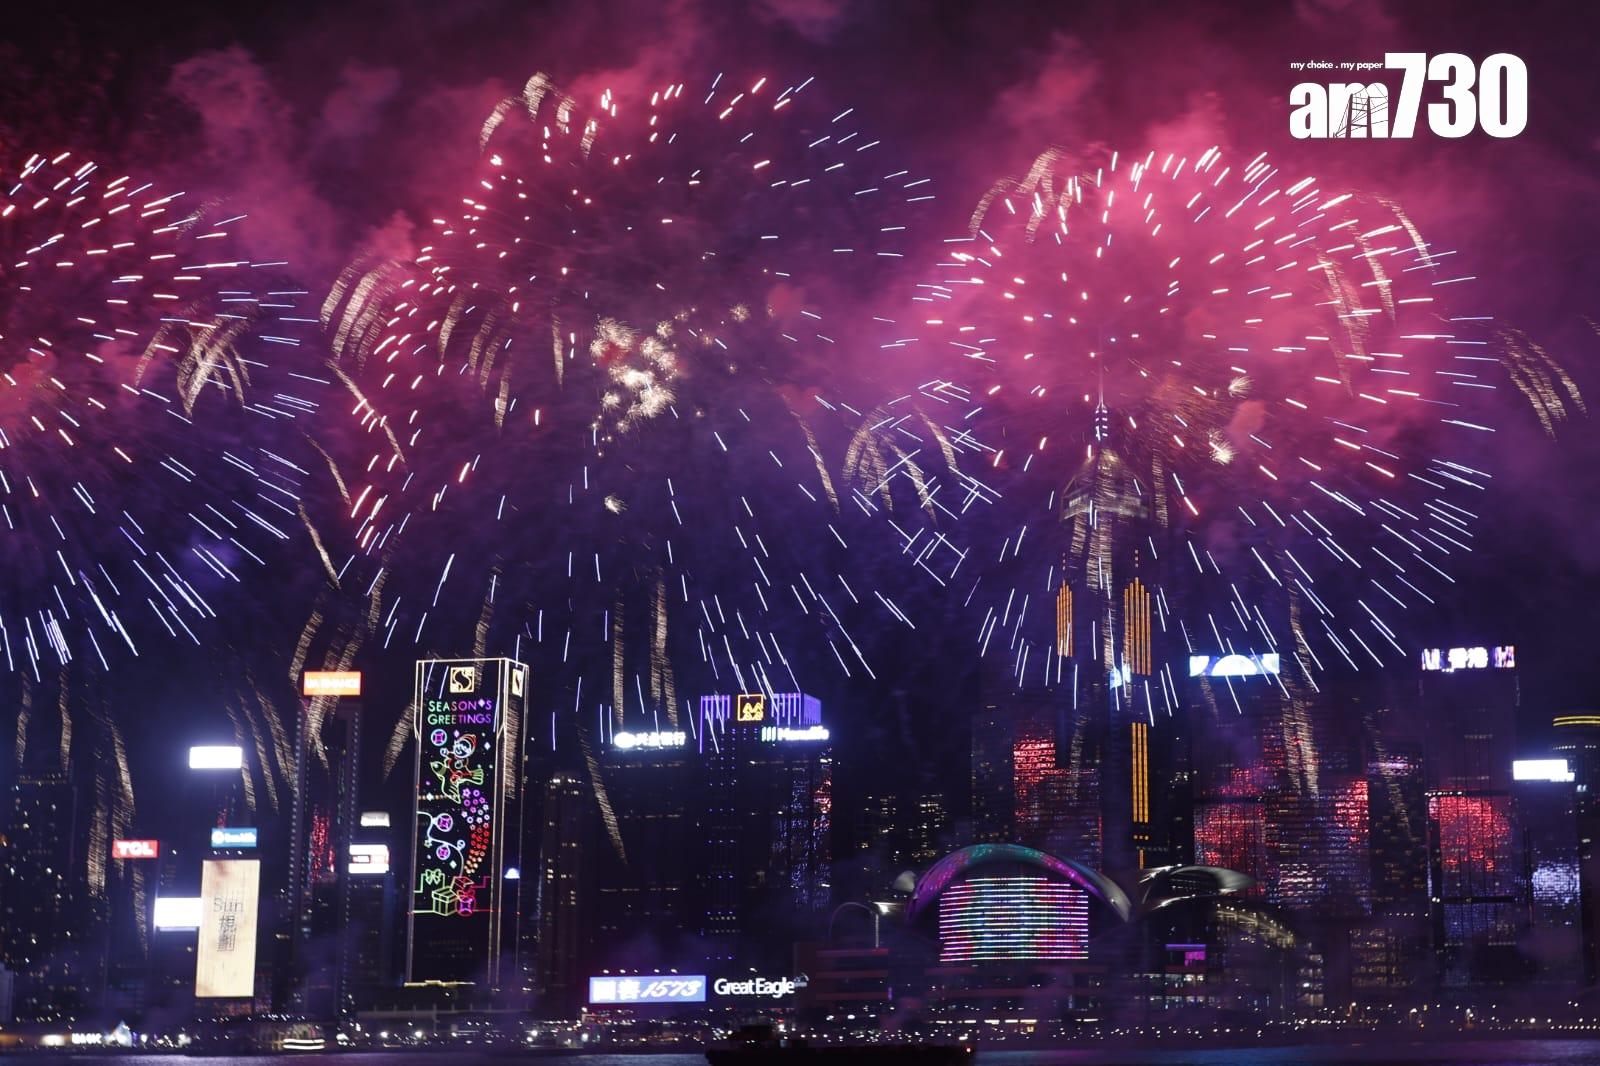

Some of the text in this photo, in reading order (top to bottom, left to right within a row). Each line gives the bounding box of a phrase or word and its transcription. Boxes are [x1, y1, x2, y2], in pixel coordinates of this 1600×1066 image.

[427, 713, 492, 725] GREETINGS
[116, 841, 154, 856] TCL
[714, 976, 795, 998] Great Eagle
